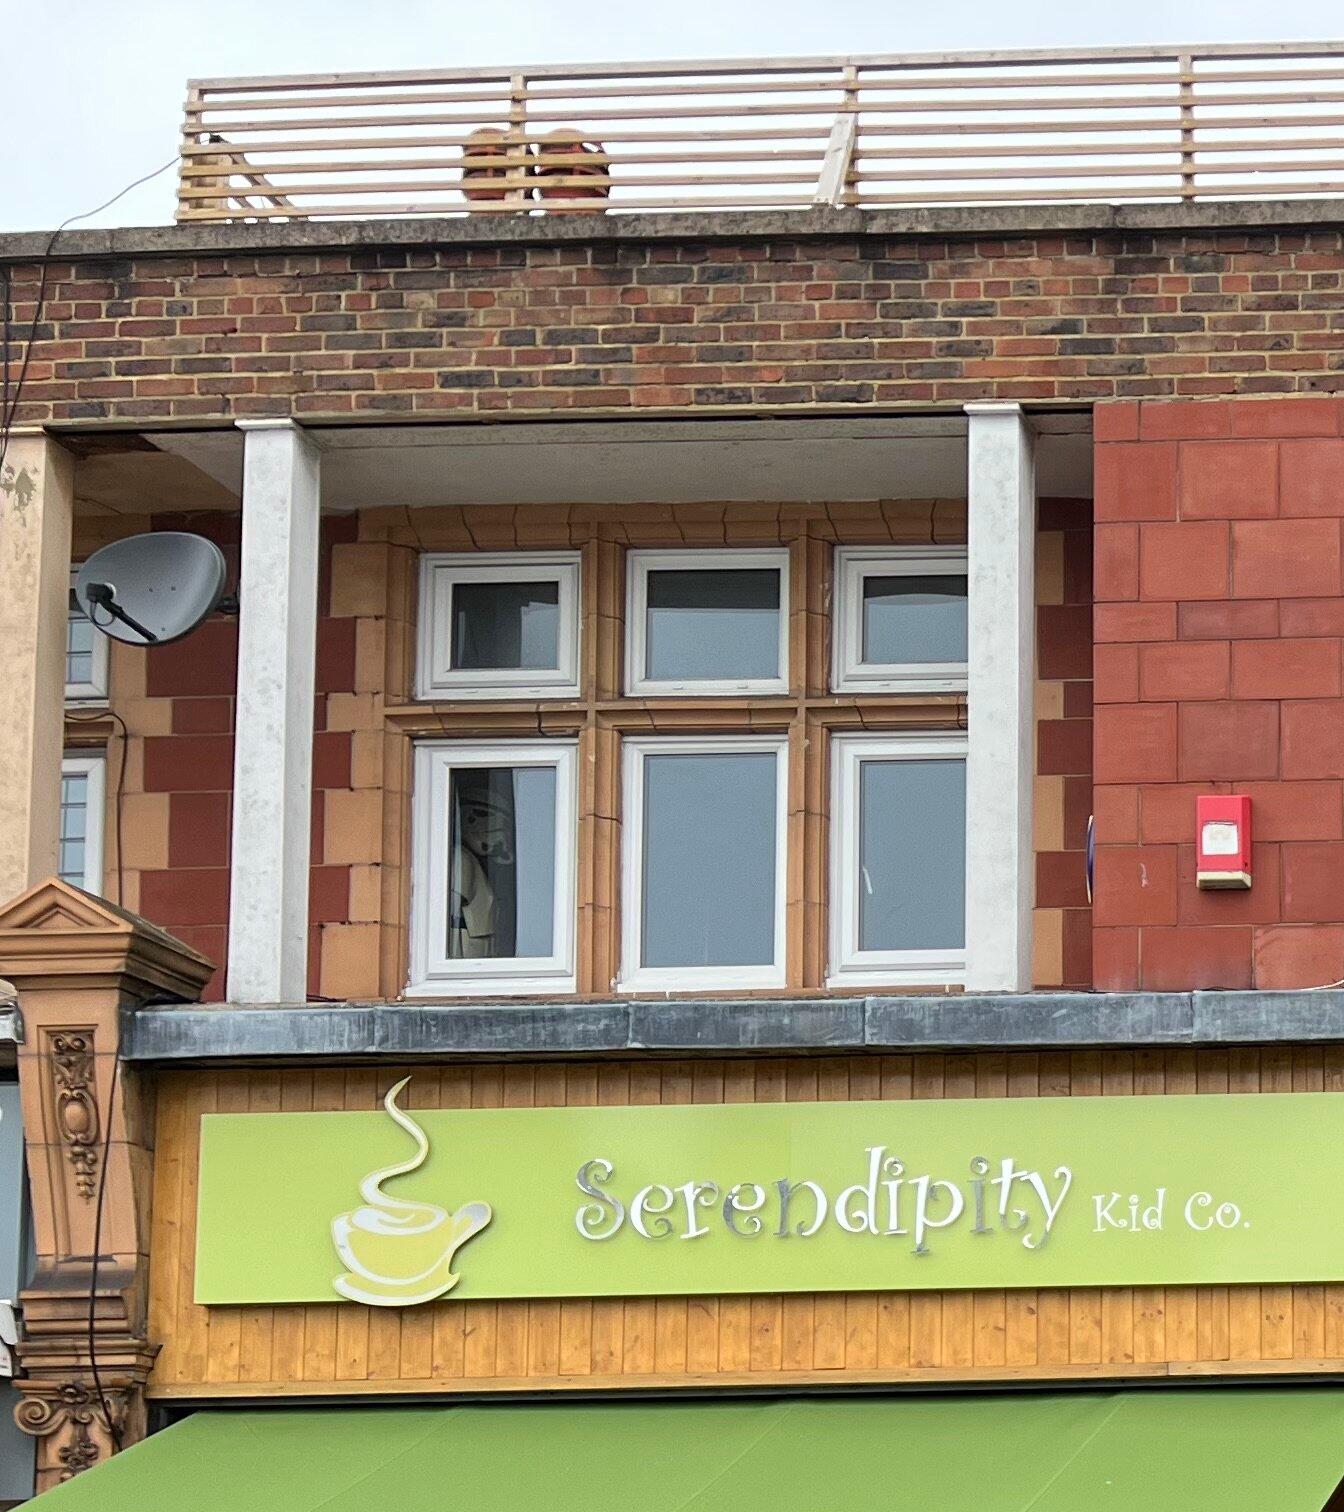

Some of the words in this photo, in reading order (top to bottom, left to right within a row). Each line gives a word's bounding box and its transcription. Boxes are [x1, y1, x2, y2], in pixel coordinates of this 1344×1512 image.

[575, 1146, 1072, 1254] Serendipity
[1092, 1188, 1167, 1232] Kid
[1184, 1192, 1250, 1231] Co.
